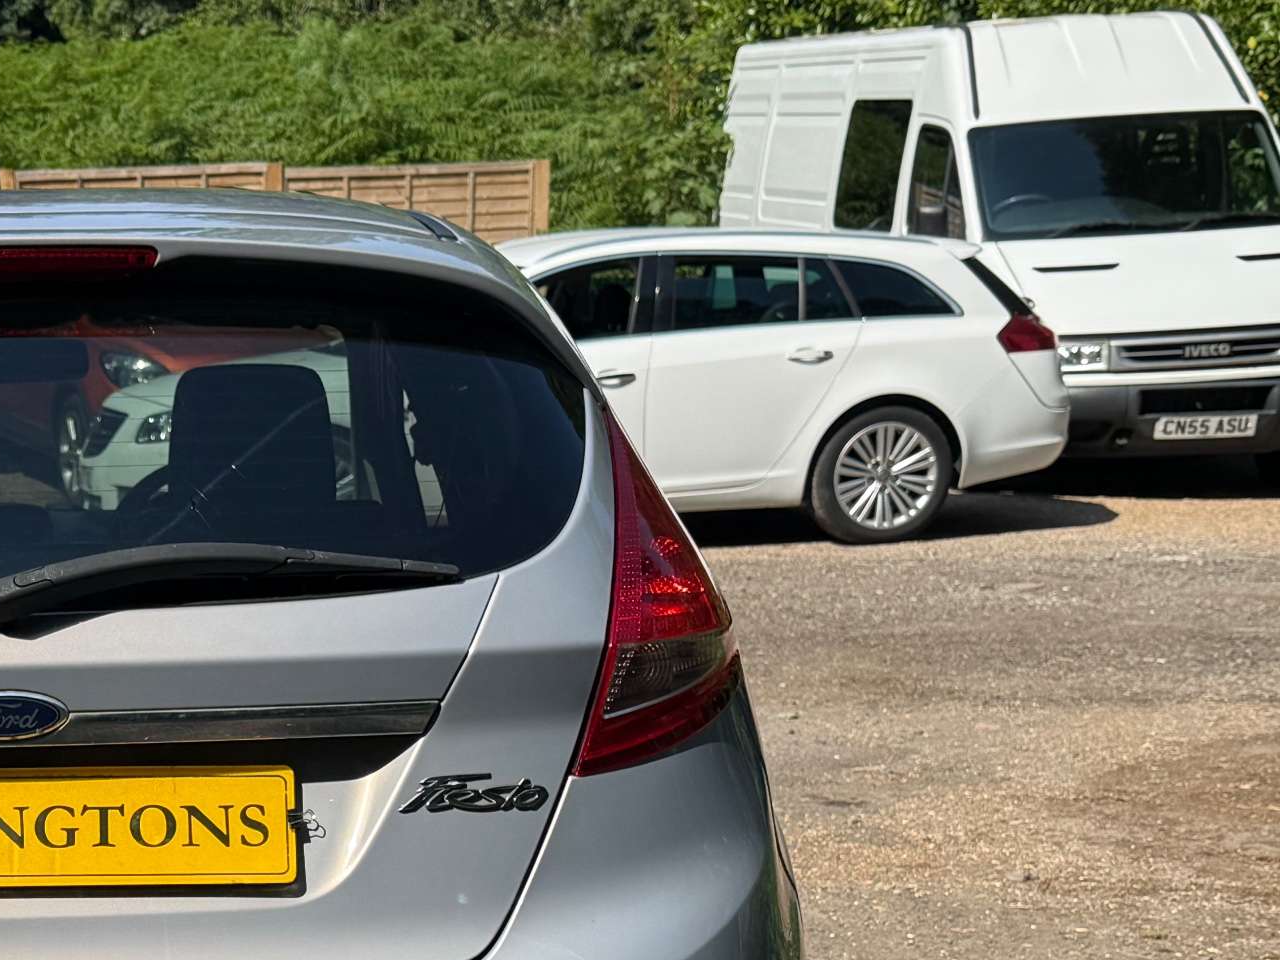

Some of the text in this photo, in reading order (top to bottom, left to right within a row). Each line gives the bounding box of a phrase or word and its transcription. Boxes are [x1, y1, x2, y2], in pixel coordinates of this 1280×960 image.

[1184, 343, 1231, 358] IVECO
[1162, 416, 1250, 435] CN55 ASU
[398, 772, 549, 814] Fiesta
